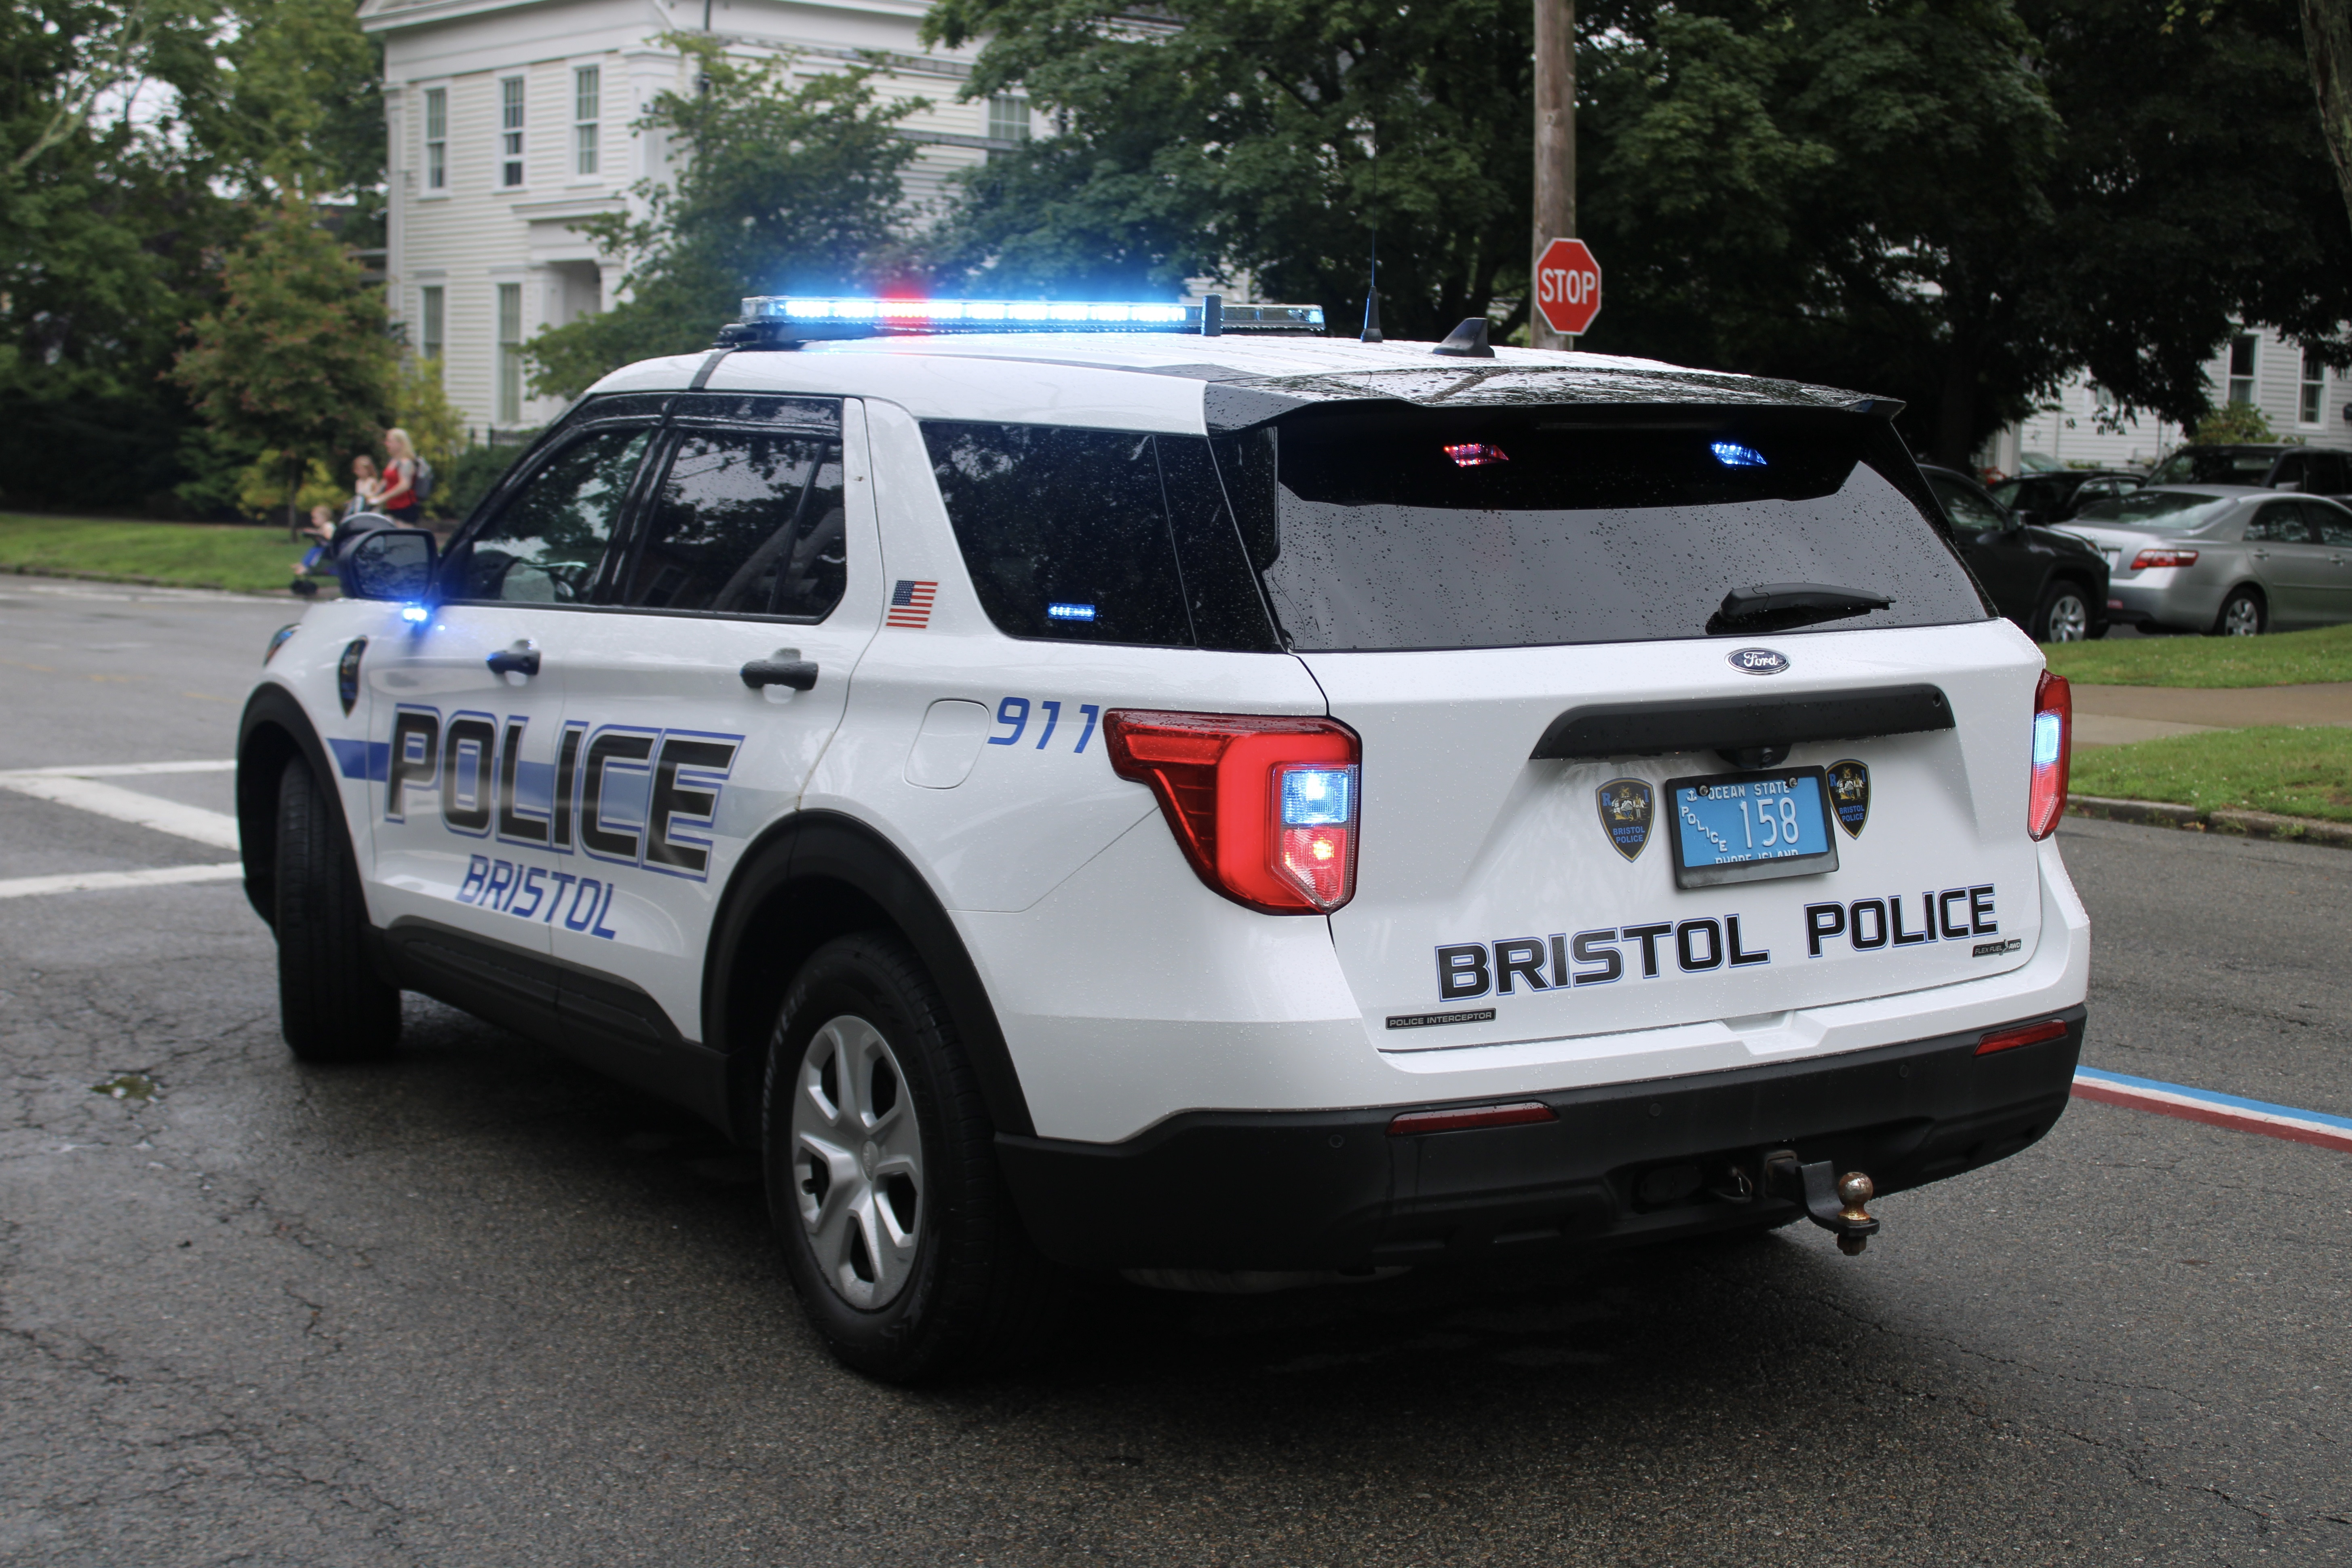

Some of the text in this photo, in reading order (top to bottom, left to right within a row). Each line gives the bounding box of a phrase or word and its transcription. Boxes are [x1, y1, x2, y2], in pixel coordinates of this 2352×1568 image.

[1540, 268, 1596, 304] STOP
[1743, 652, 1778, 667] Ford
[987, 696, 1099, 753] 911
[1829, 770, 1866, 787] R I
[384, 702, 746, 883] POLICE
[1601, 789, 1649, 806] R I
[1708, 781, 1790, 800] OCEAN STATE
[1839, 805, 1864, 814] BRISTOL
[1842, 813, 1863, 822] POLICE
[1613, 826, 1645, 836] BRISTOL
[1681, 806, 1728, 852] POLICE
[1740, 797, 1799, 848] 158
[1616, 834, 1643, 844] POLICE
[456, 853, 616, 940] BRISTOL
[1434, 884, 1998, 1003] BRISTOL POLICE
[1389, 1012, 1492, 1027] POLICE INTERCEPTOR
